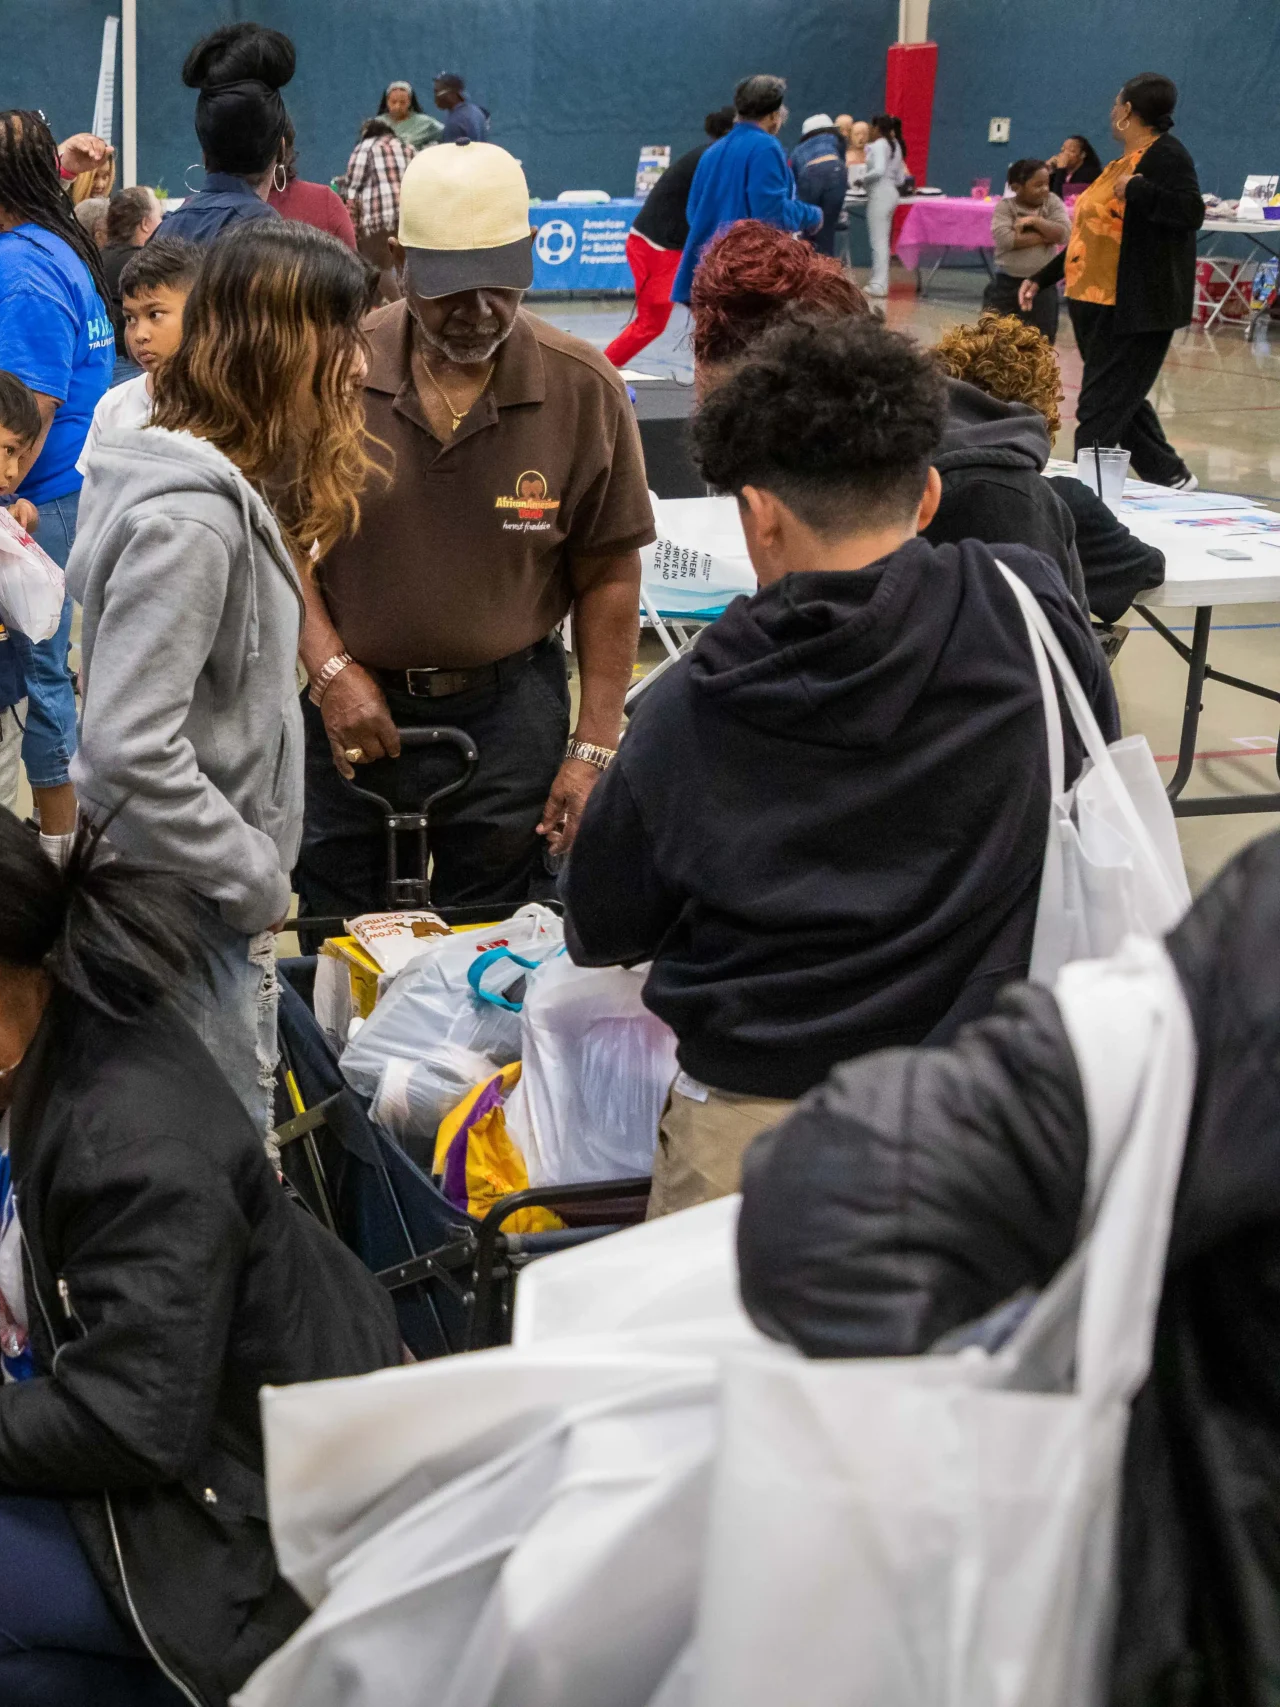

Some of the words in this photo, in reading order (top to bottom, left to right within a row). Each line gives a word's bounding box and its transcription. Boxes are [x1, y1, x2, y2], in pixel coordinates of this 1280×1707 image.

[583, 219, 625, 229] American
[656, 541, 663, 550] IN
[672, 546, 680, 569] HRIVE
[688, 550, 698, 578] WHERE
[671, 570, 678, 579] IN
[354, 914, 404, 934] Oatmeal
